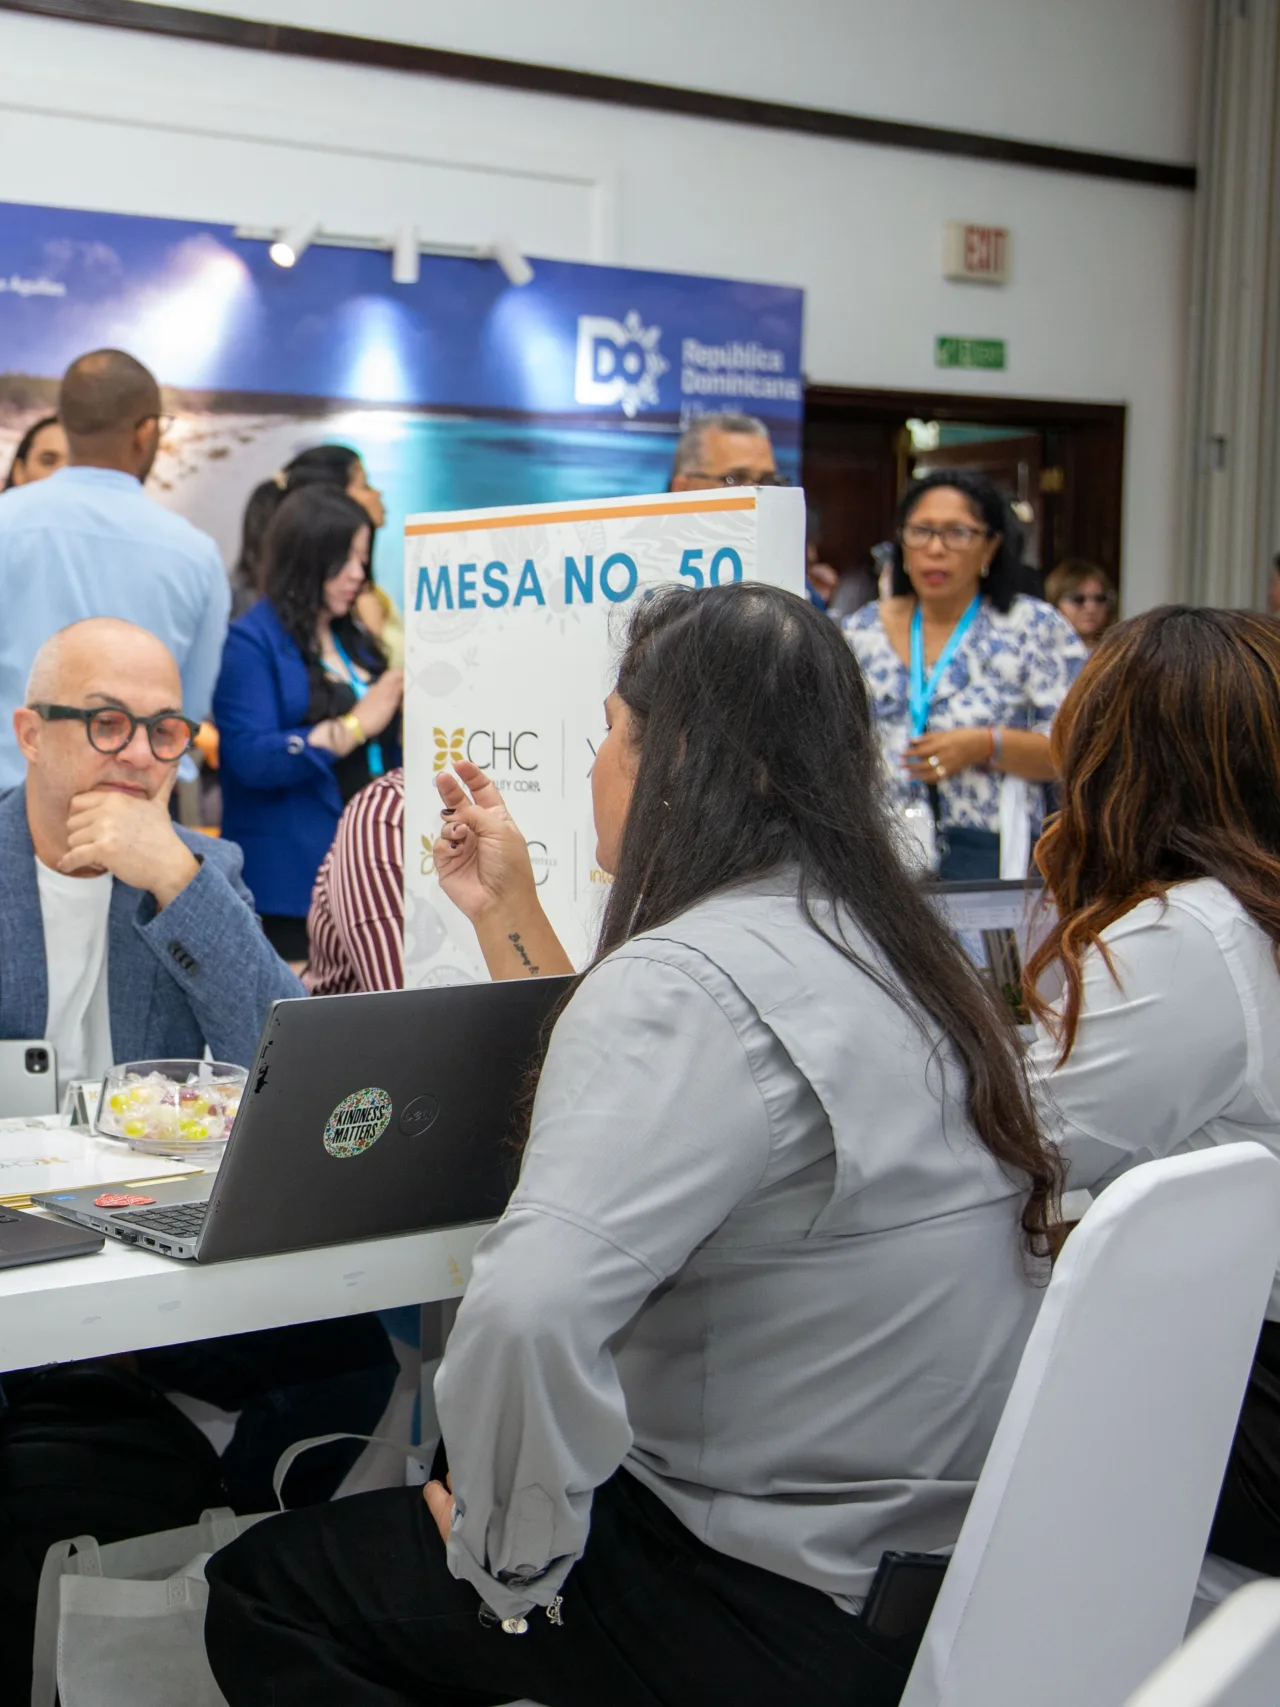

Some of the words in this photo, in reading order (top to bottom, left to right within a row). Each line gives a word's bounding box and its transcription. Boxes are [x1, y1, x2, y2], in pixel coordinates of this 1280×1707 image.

[965, 224, 1007, 274] EXIT
[681, 337, 785, 373] República
[681, 367, 800, 401] Dominicana
[414, 559, 546, 611] MESA
[679, 546, 743, 591] 50
[467, 730, 539, 771] CHC
[332, 1123, 378, 1143] MATTERS
[336, 1105, 385, 1126] KINDNESS
